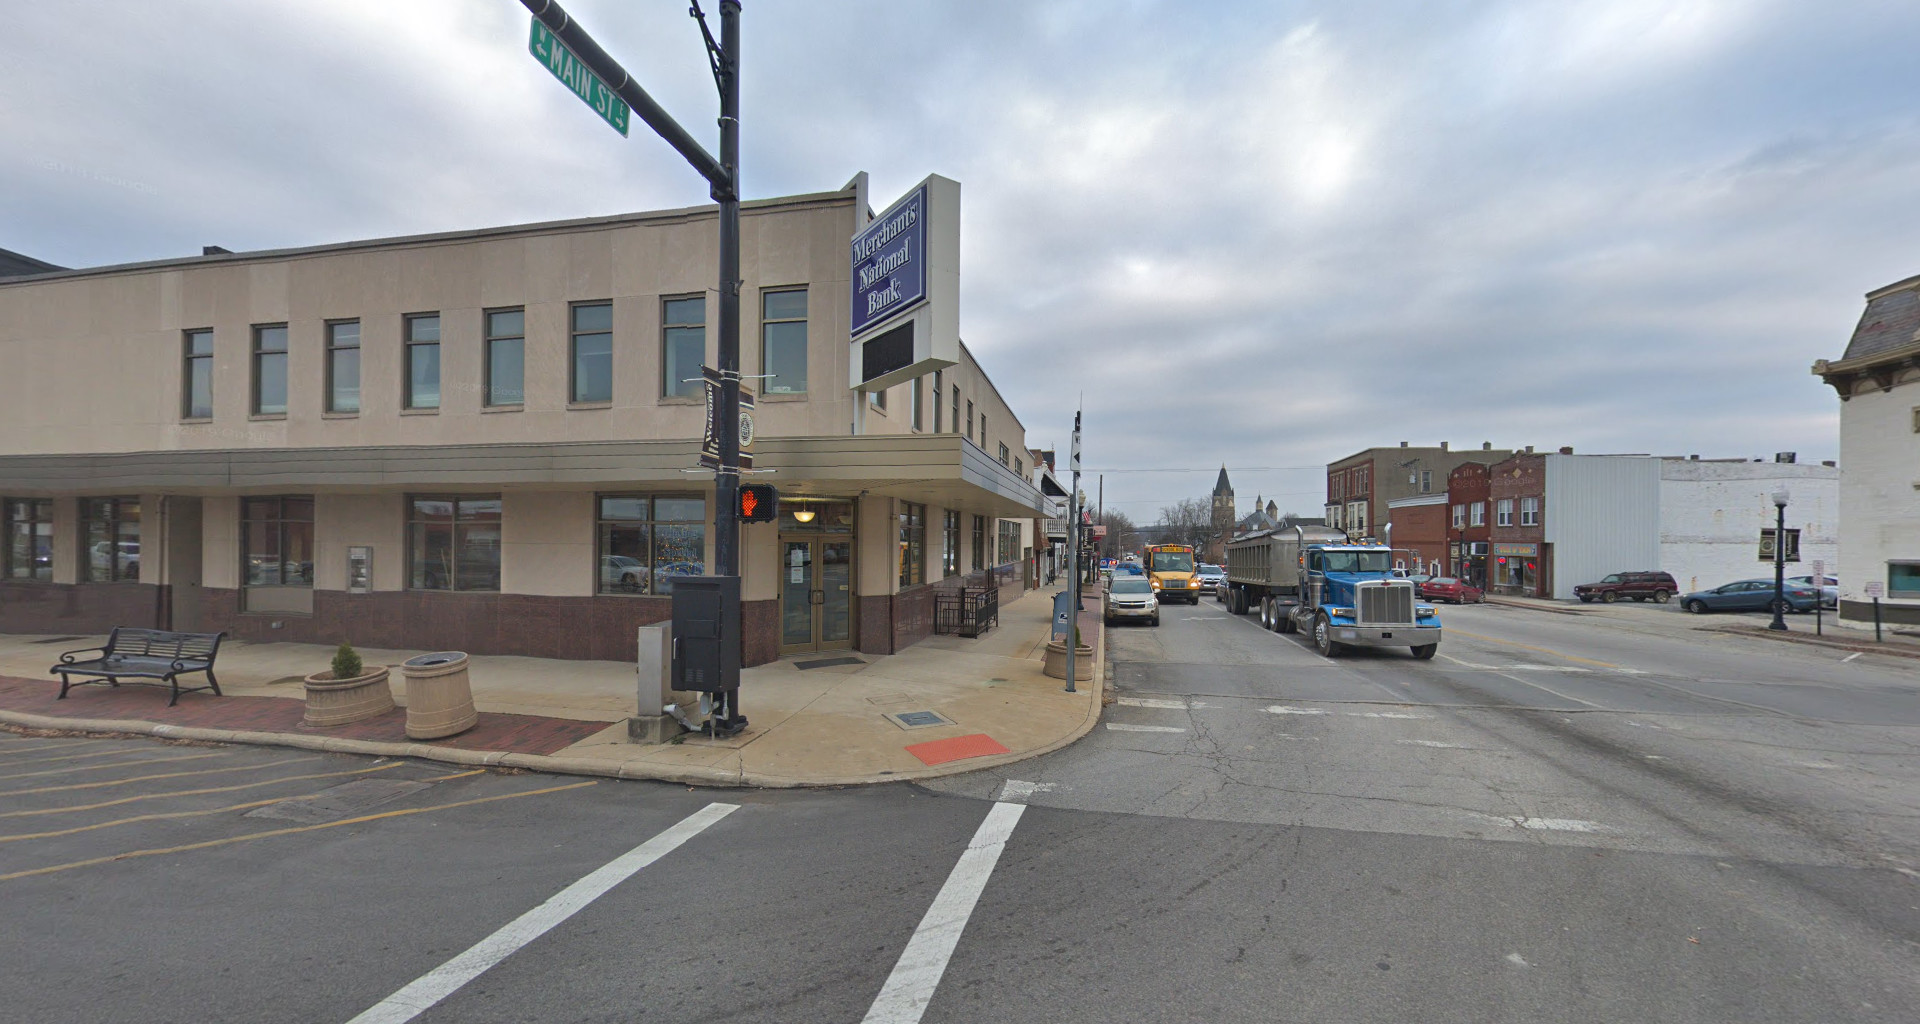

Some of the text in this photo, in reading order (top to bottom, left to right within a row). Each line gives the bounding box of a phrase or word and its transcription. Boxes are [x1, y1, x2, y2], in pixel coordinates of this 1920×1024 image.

[539, 26, 546, 41] W
[550, 39, 616, 120] MAIN ST
[619, 104, 624, 116] E
[859, 236, 911, 293] National
[867, 278, 901, 317] Bank
[705, 382, 713, 442] Welcome
